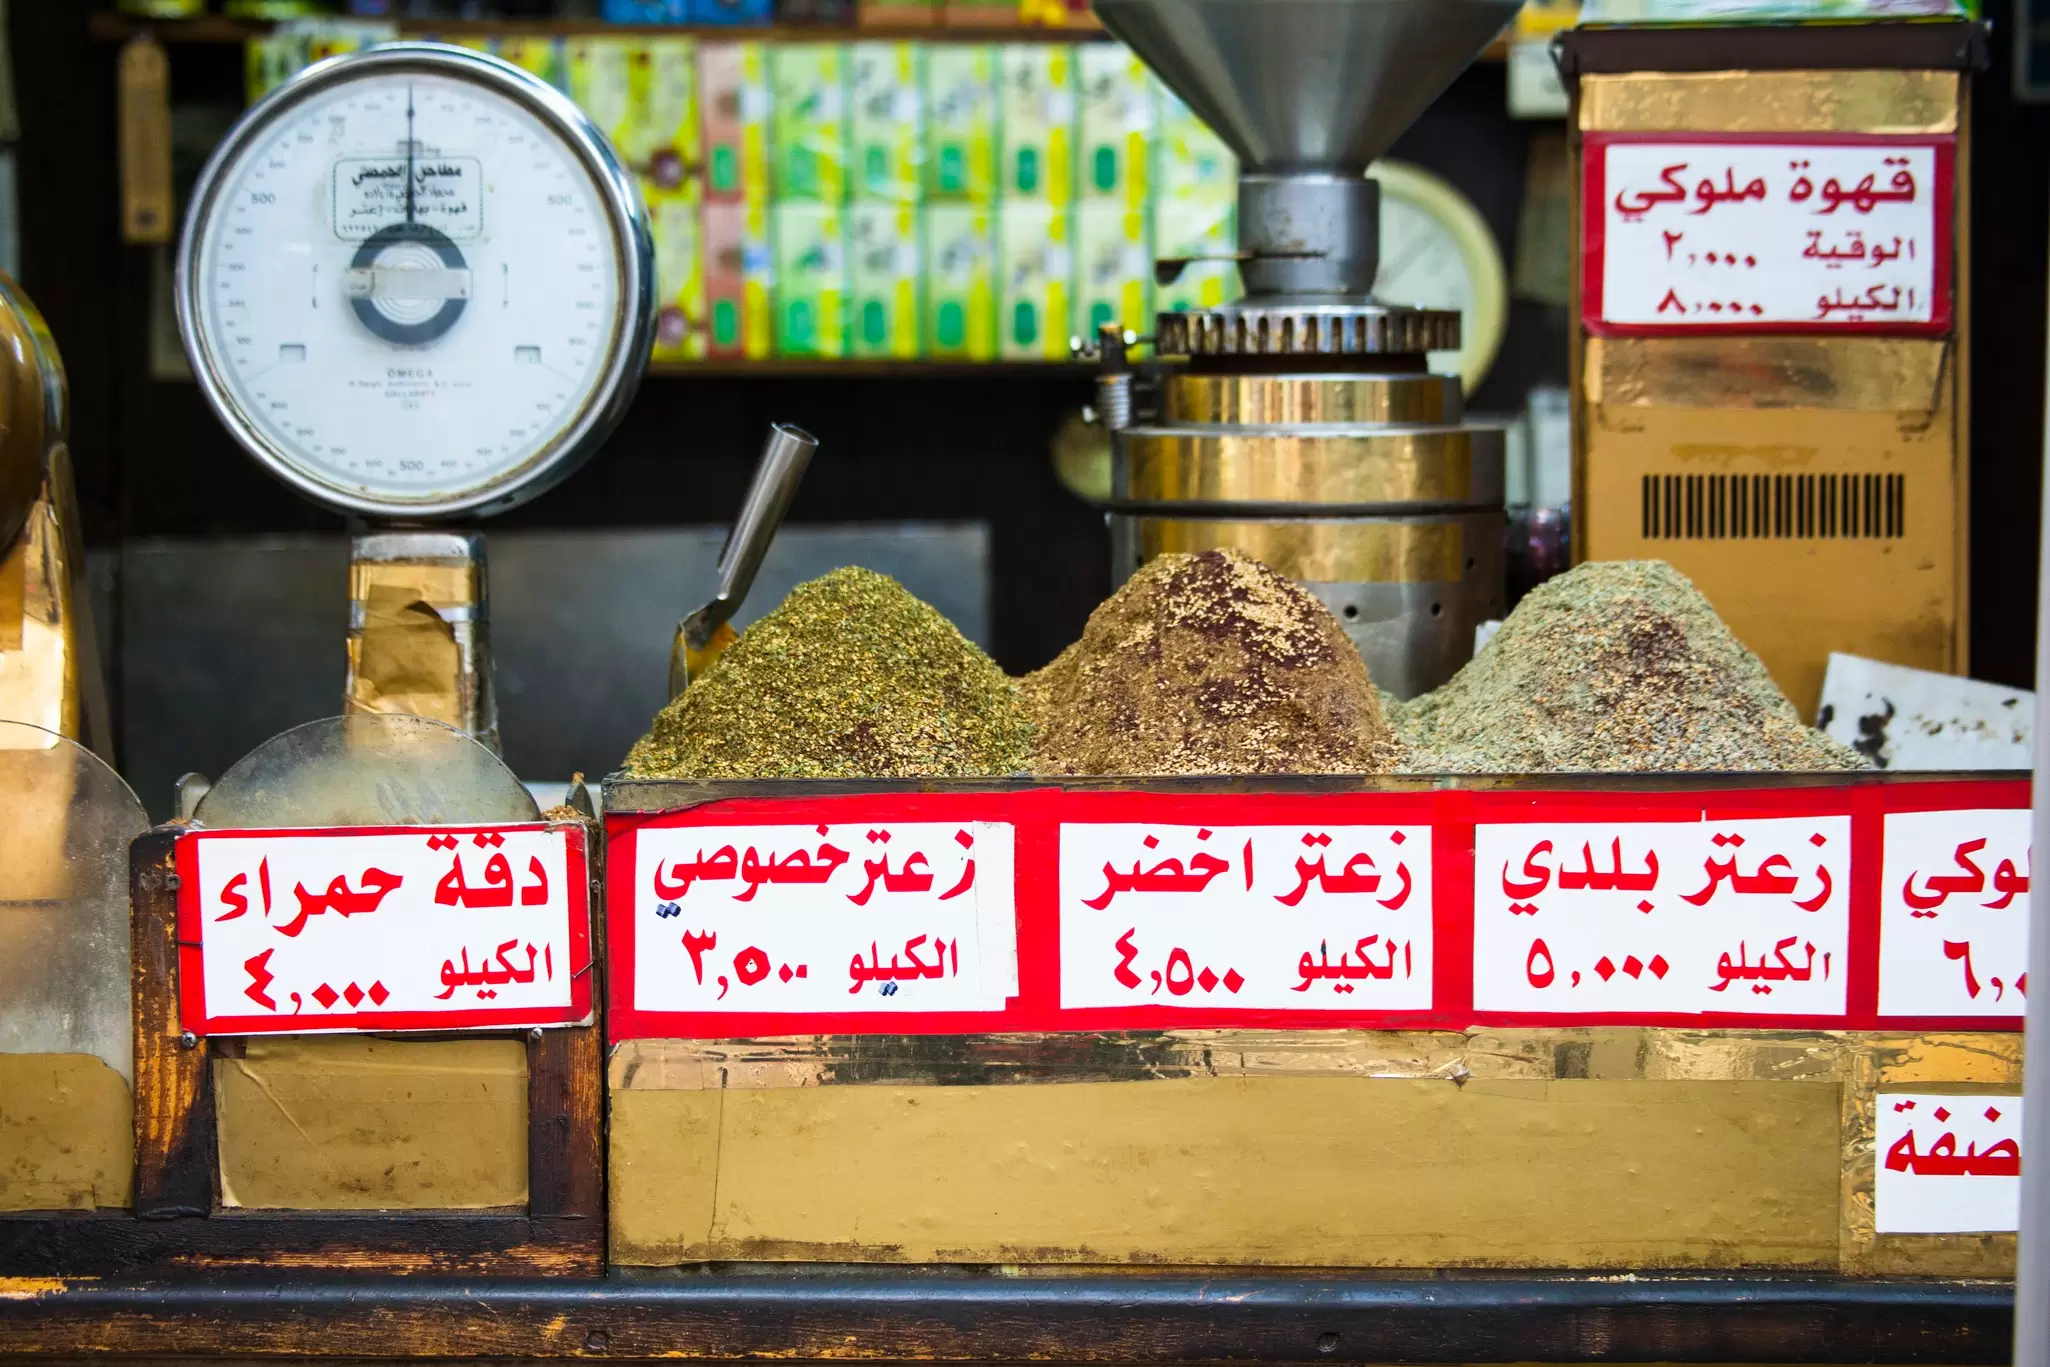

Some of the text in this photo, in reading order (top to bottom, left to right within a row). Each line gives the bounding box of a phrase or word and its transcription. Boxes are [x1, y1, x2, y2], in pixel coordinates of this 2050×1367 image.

[1614, 156, 1917, 223] قهوة ملوكي
[1802, 230, 1916, 269] الوقية
[1815, 285, 1916, 321] الكيلو
[399, 461, 425, 472] 500
[213, 833, 550, 939] دقة حمراء
[653, 825, 975, 919] زعتر خصوصي
[1080, 828, 1413, 911] زعتر اخضر
[1501, 832, 1833, 917] زعتر بلدي
[433, 938, 554, 1001] الكيلو
[848, 933, 959, 997] الكيلو
[1289, 933, 1413, 995] الكيلو
[1707, 935, 1832, 996] الكيلو
